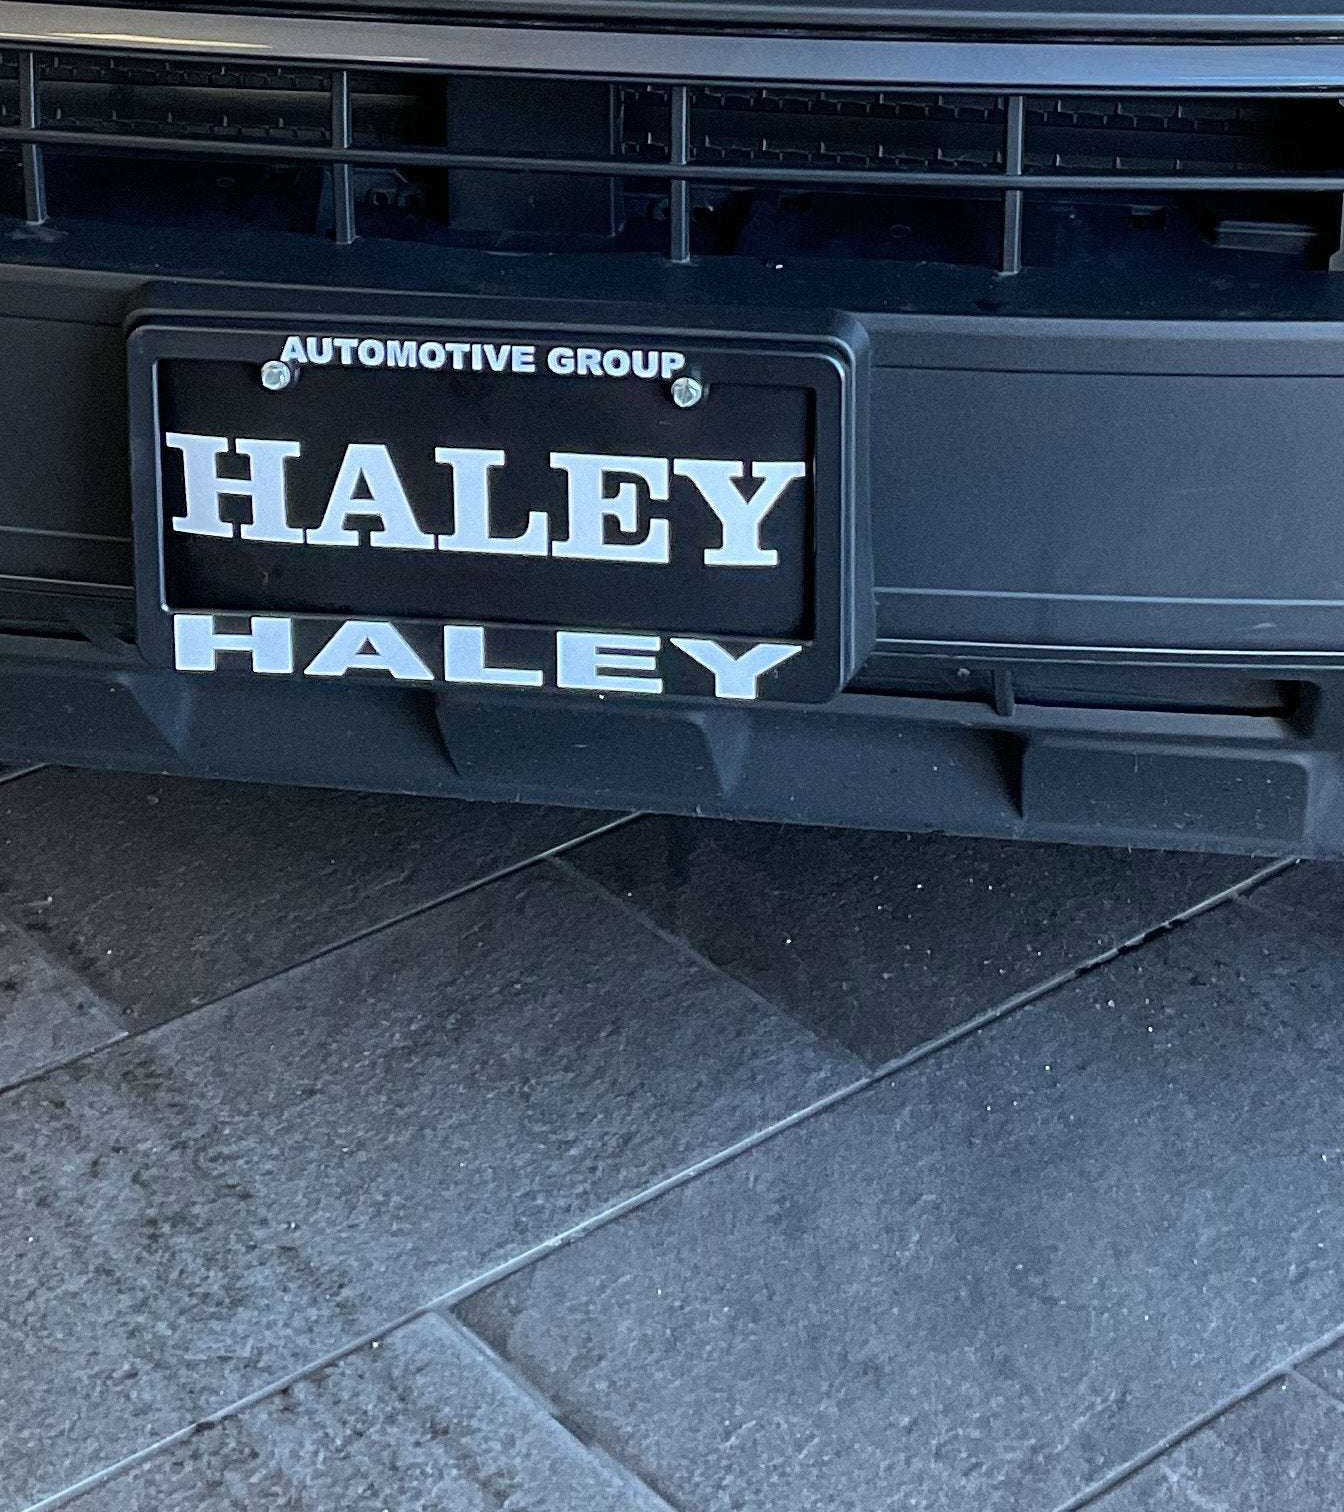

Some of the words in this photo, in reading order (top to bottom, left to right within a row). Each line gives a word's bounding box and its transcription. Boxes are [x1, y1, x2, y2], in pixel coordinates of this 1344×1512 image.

[280, 335, 536, 374] AUTOMOTIVE
[547, 346, 687, 380] GROUP
[165, 432, 806, 567] HALEY
[173, 613, 803, 700] HALEY
